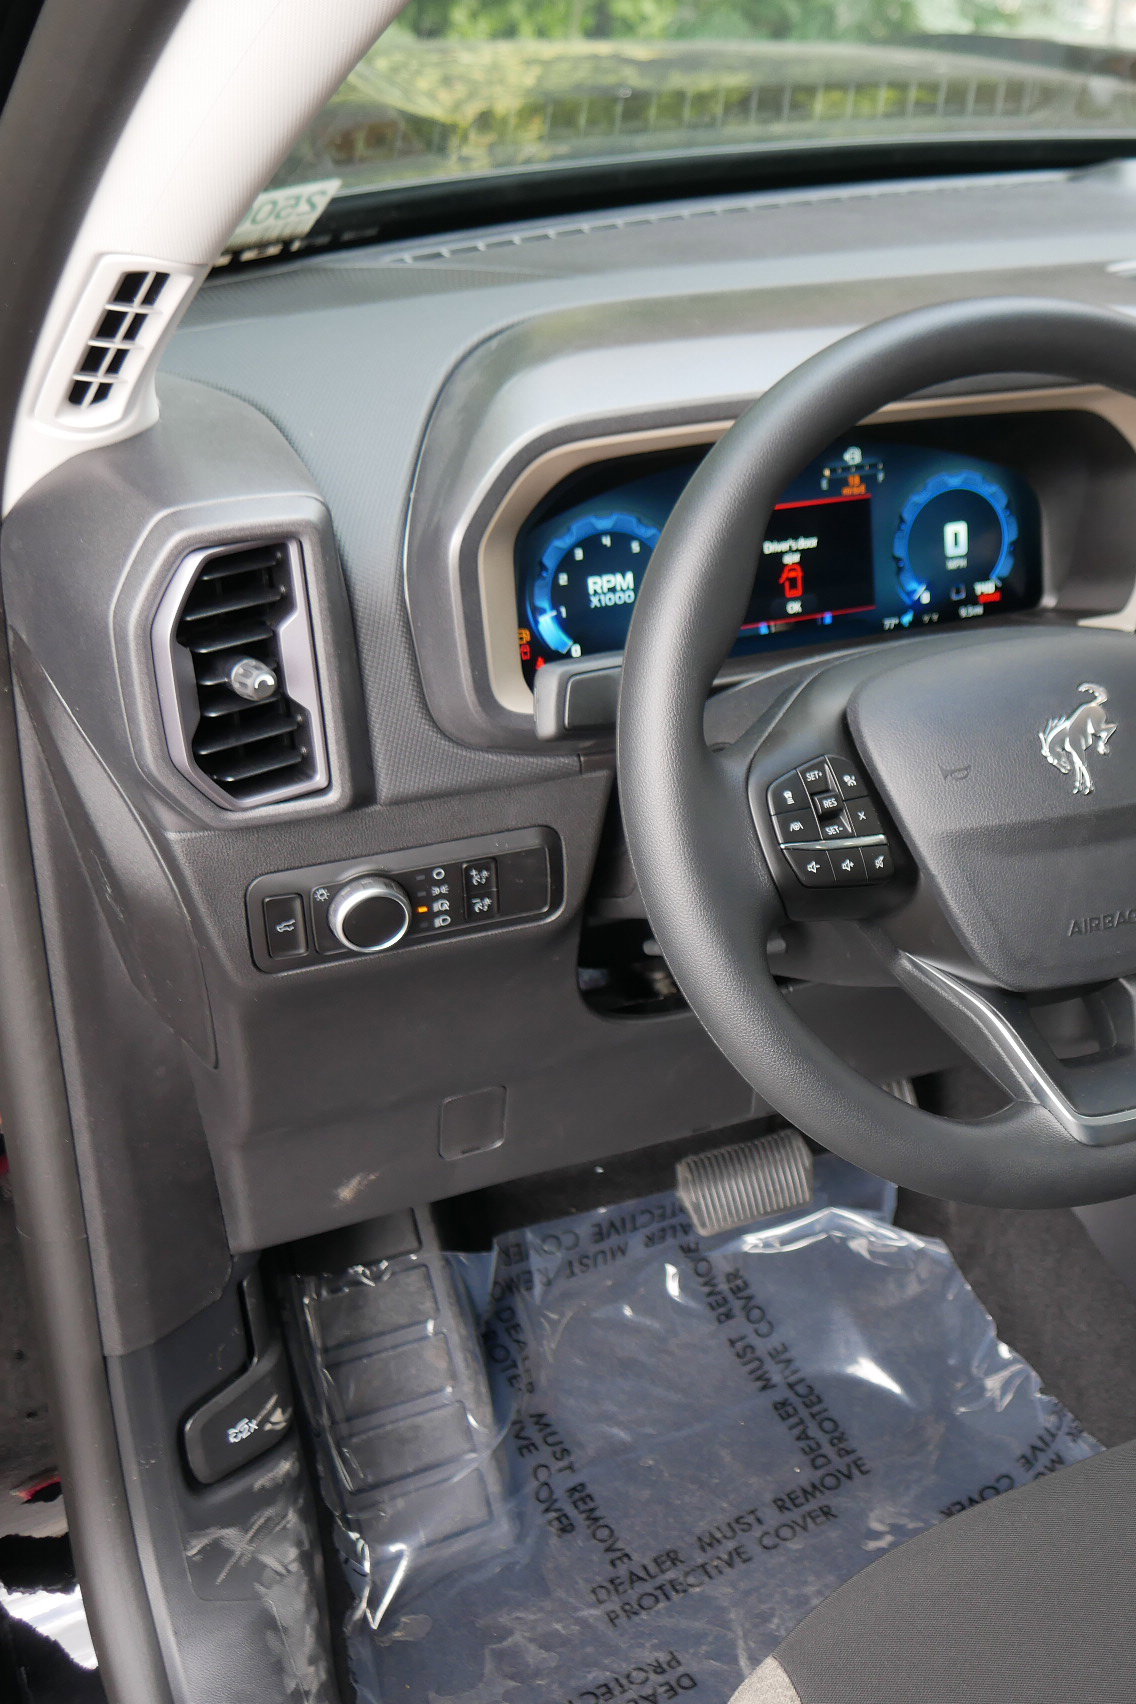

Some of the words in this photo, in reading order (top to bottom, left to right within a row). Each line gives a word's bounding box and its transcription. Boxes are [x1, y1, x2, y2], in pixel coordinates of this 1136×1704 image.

[601, 534, 612, 547] 4
[943, 520, 968, 557] 0
[587, 571, 634, 595] RPM
[589, 590, 636, 609] X1000
[559, 605, 567, 618] 1
[570, 643, 582, 658] 0
[805, 770, 822, 782] SET+
[822, 798, 838, 809] RES
[566, 1241, 630, 1278] MUST
[725, 1267, 775, 1339] COVER
[727, 1334, 778, 1393] MUST
[767, 1342, 858, 1460] PROTECTIVE
[772, 1397, 832, 1471] DEALER
[529, 1412, 577, 1474] MUST
[565, 1482, 633, 1569] REMOVE
[533, 1463, 576, 1539] COVER
[590, 1550, 685, 1606] DEALER
[695, 1508, 765, 1555] MUST
[771, 1456, 871, 1515] REMOVE
[605, 1544, 754, 1628] PROTECTIVE
[758, 1504, 838, 1551] COVER
